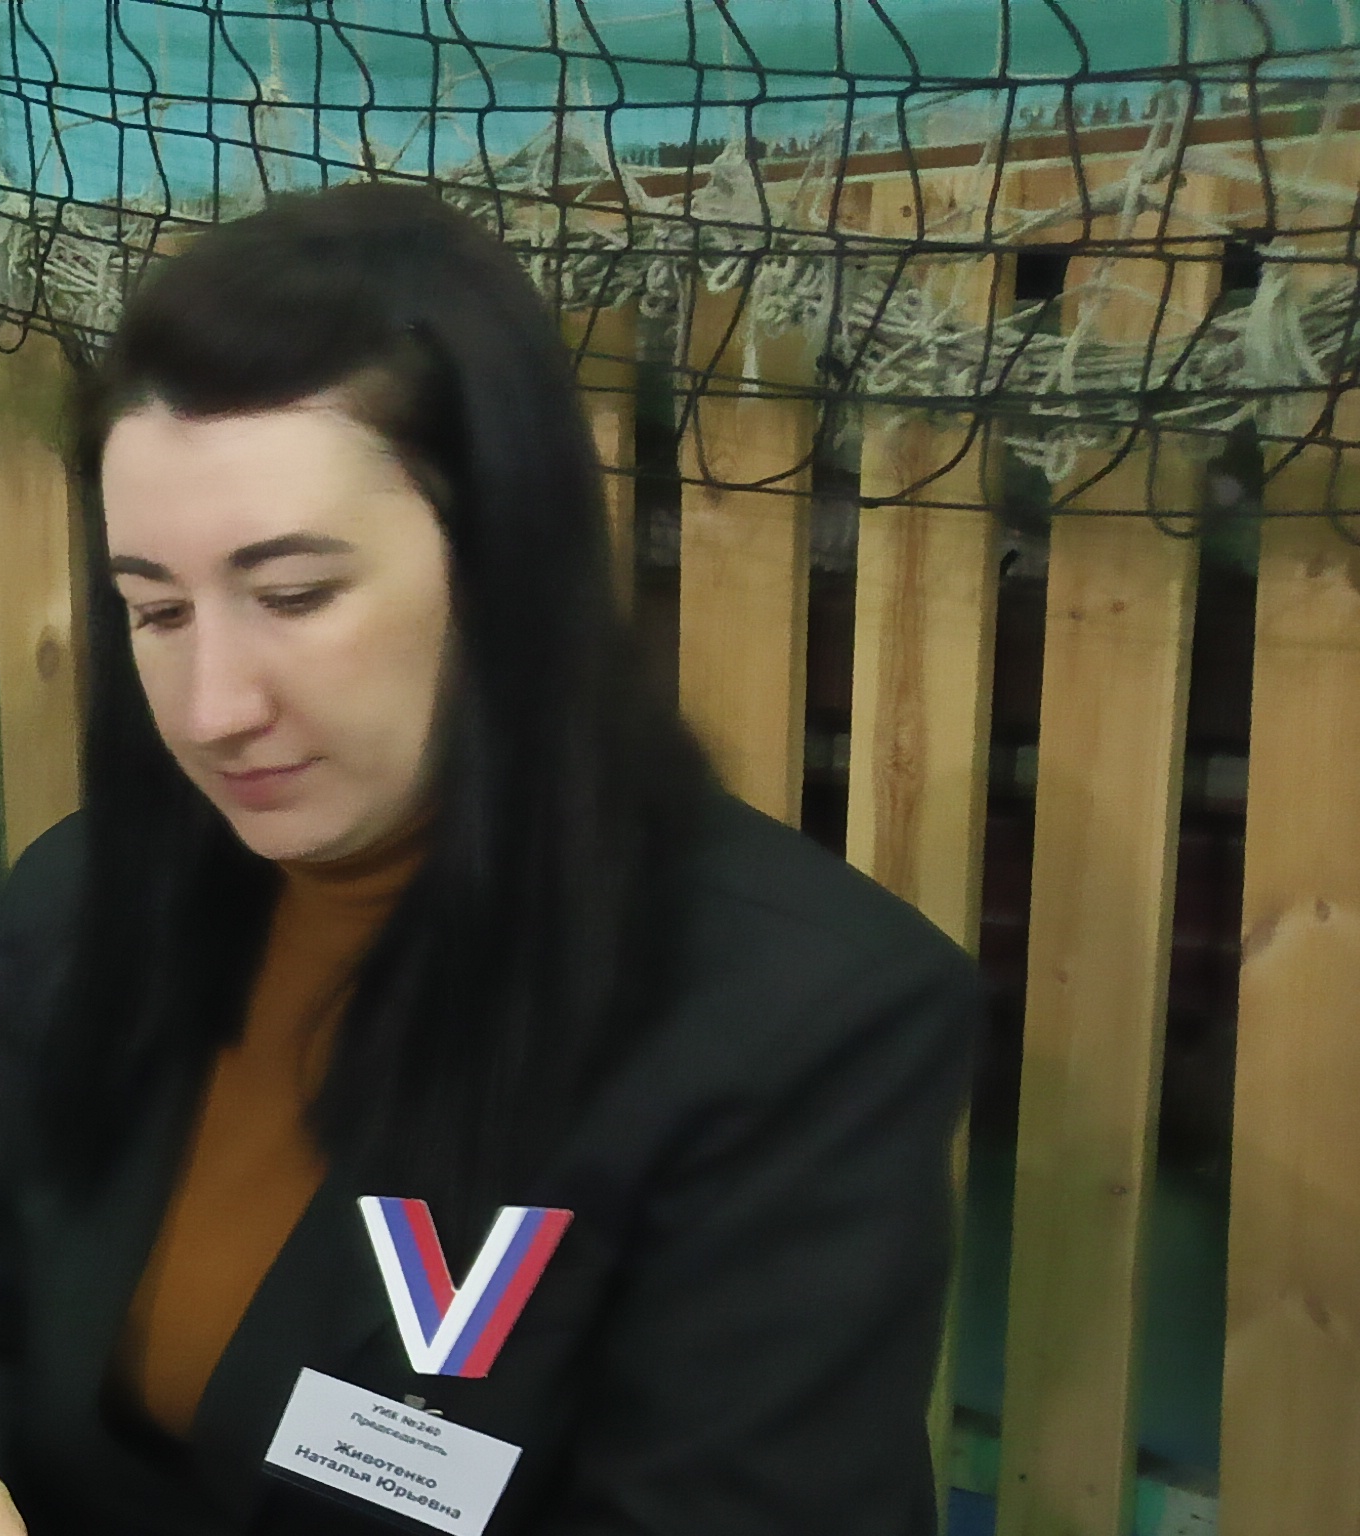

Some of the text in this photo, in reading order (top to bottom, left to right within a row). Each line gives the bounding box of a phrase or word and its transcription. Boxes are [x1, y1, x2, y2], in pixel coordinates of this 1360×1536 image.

[350, 1411, 448, 1456] Председатель
[294, 1443, 461, 1520] Наталья Юрьевна
[333, 1439, 438, 1489] Животенко
